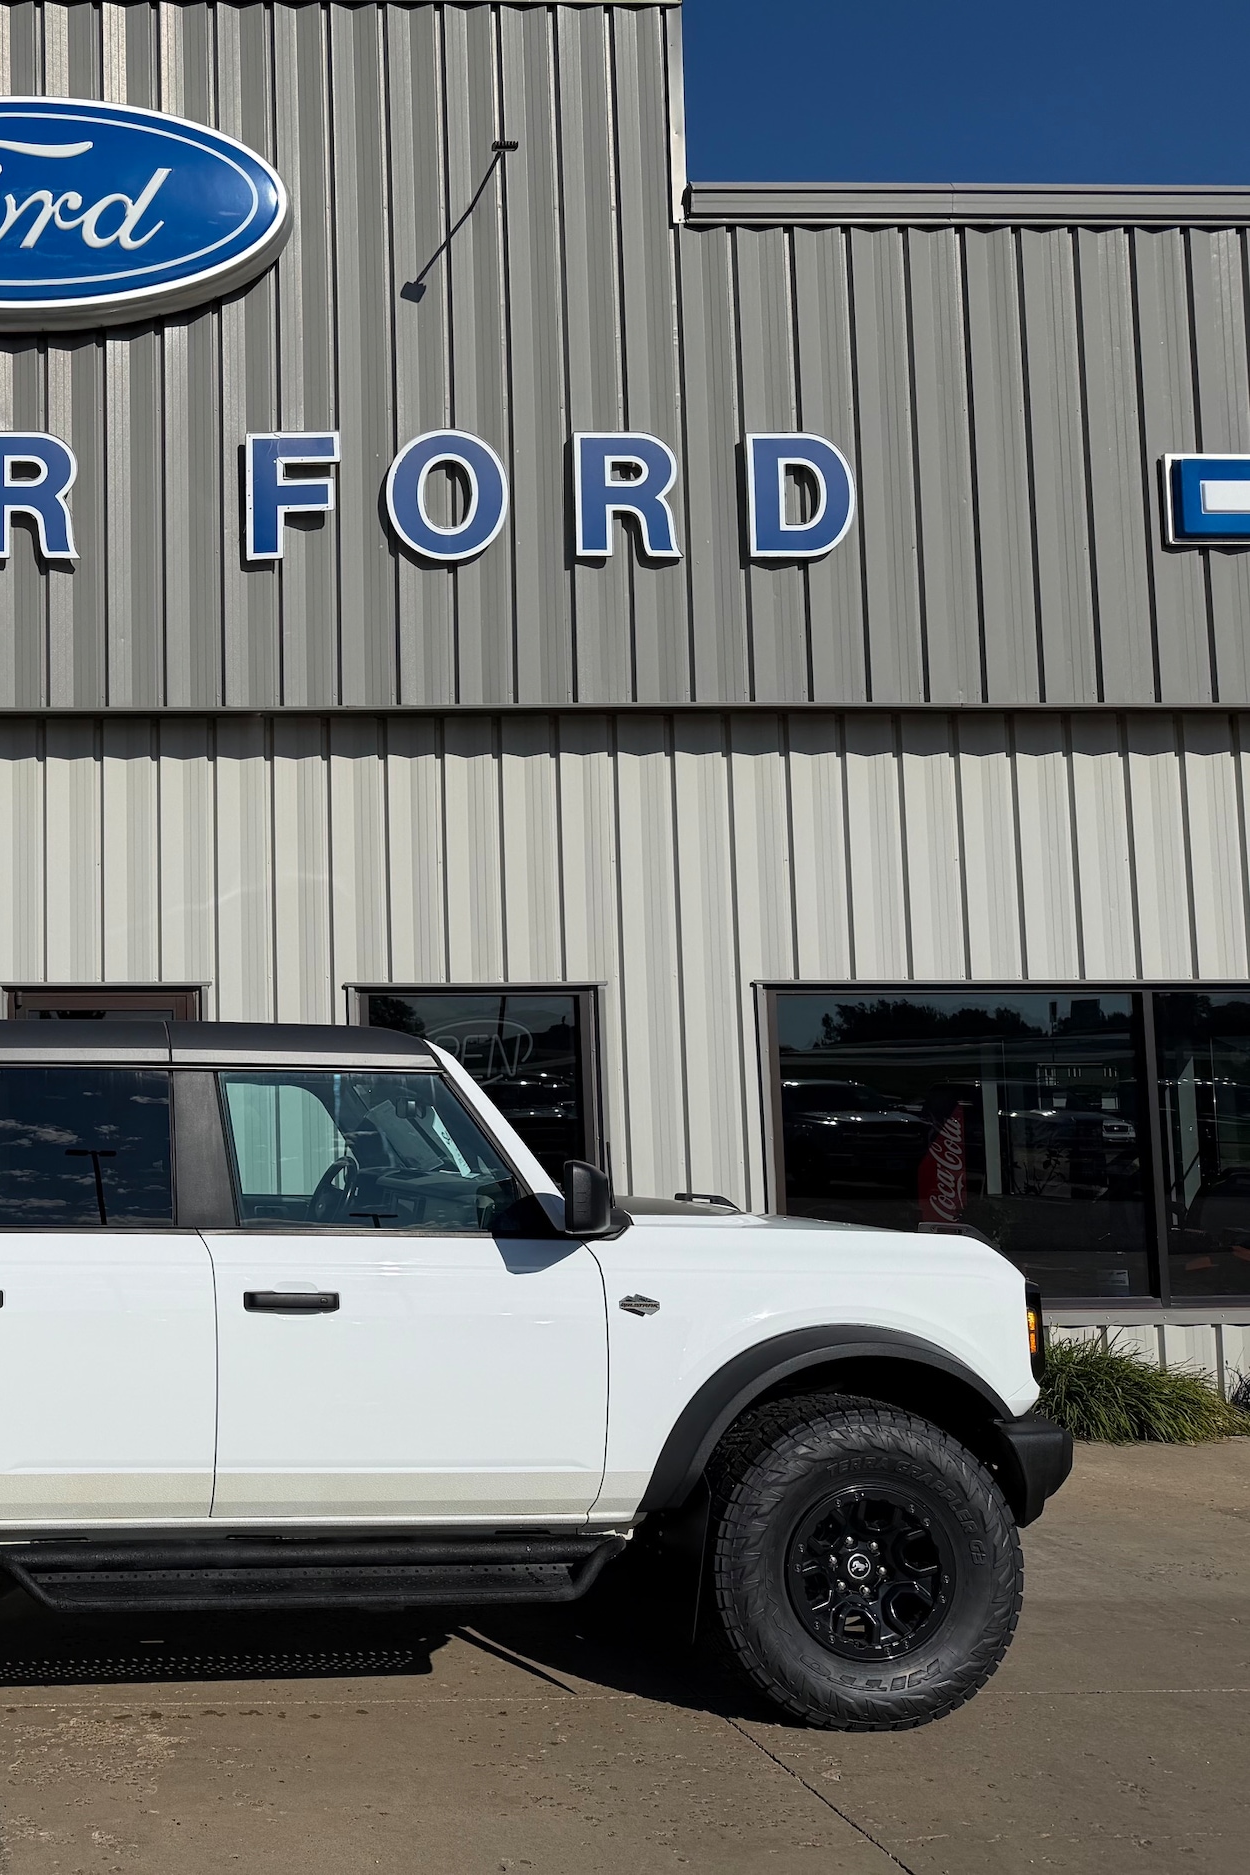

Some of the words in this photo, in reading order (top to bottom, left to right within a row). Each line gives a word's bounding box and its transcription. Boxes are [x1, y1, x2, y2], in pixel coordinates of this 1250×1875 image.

[246, 428, 855, 560] FORD
[434, 1033, 521, 1079] PEN
[826, 1456, 889, 1476] TERRA
[895, 1460, 979, 1534] GRAPPLER
